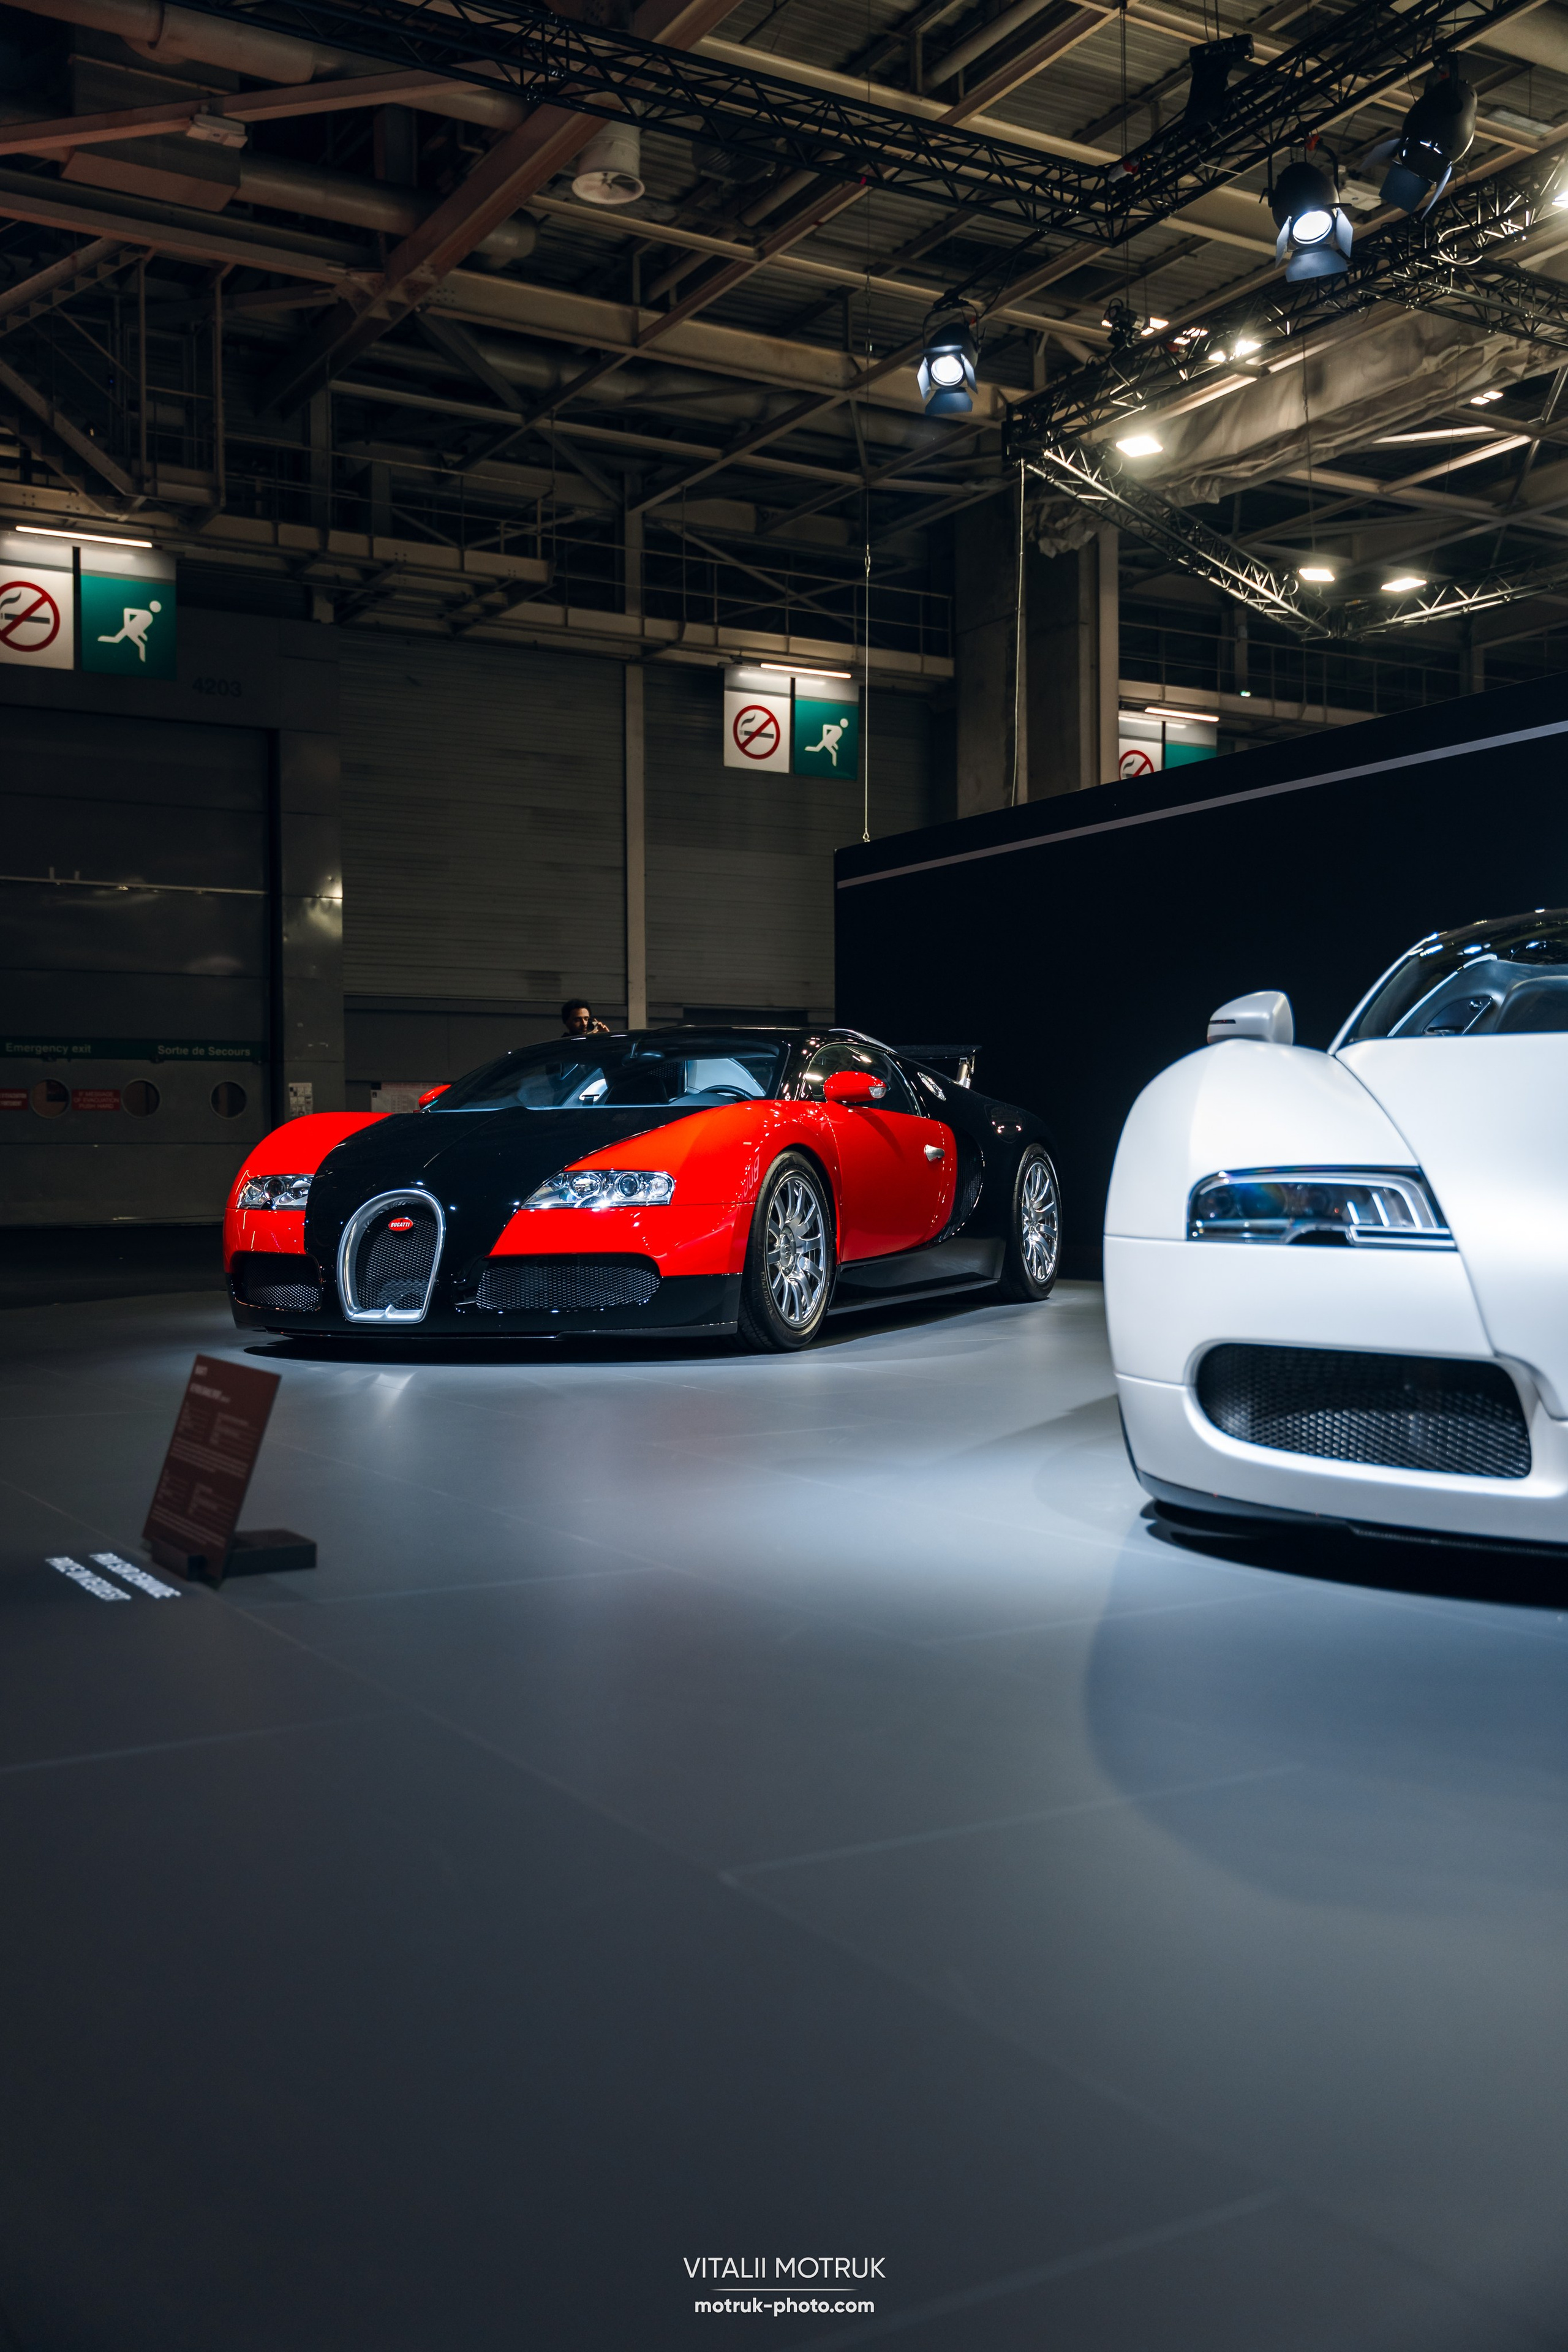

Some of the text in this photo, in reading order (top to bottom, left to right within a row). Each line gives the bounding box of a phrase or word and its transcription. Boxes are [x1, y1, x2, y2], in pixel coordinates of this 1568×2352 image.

[192, 677, 242, 698] 4203
[5, 1042, 91, 1055] Emergency exit
[157, 1045, 251, 1056] Sortie de Secours
